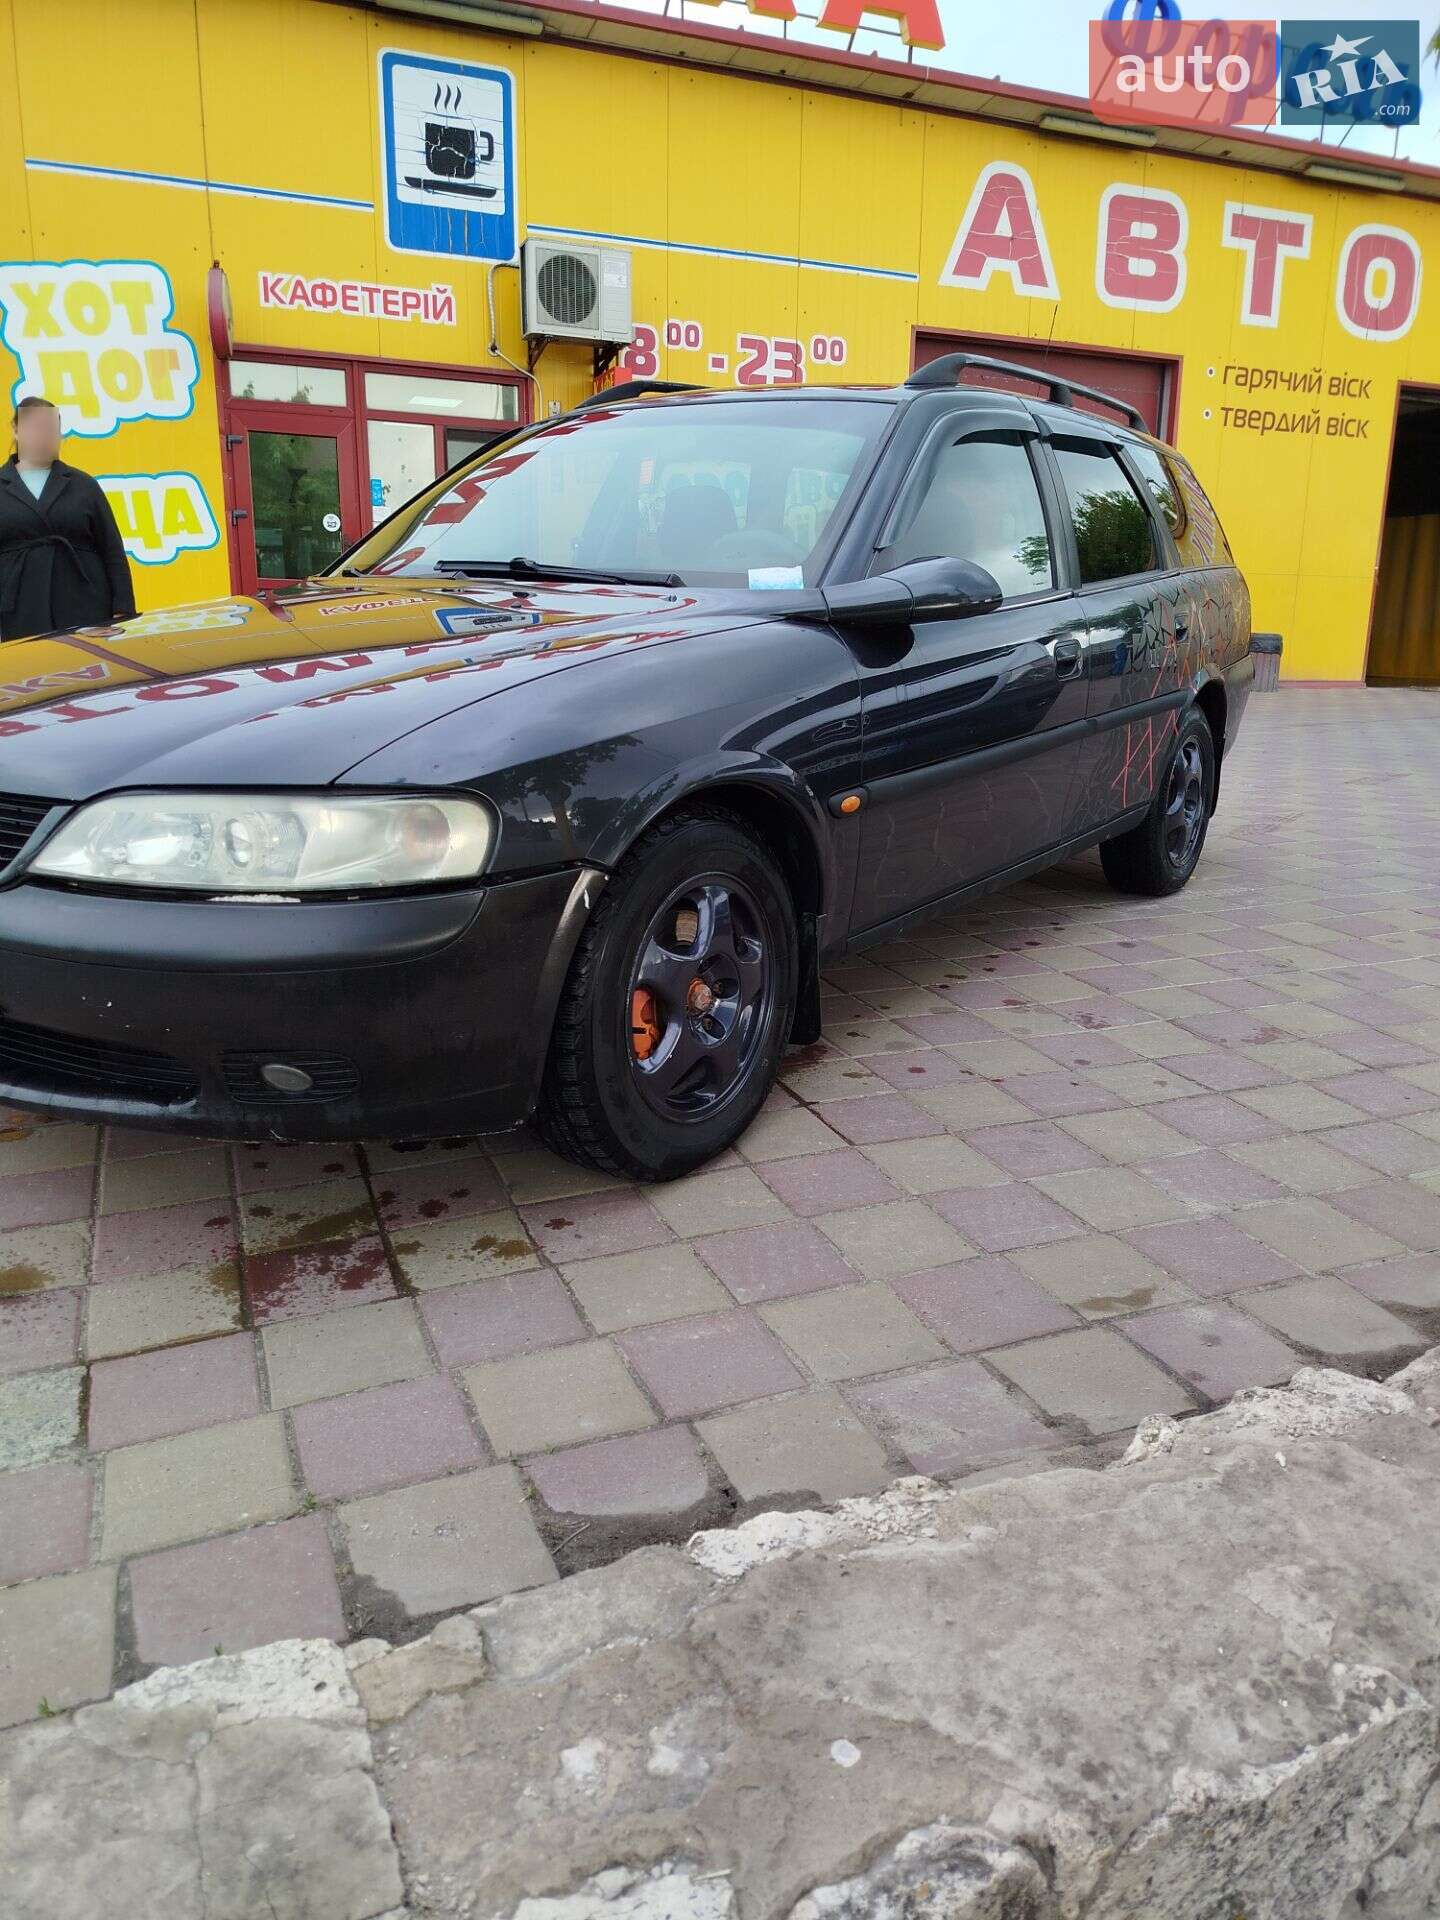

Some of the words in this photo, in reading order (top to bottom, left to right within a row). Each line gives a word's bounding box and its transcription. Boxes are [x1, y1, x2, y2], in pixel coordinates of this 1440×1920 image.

[943, 165, 1421, 337] АВТО
[9, 280, 154, 338] ХОТ
[260, 275, 454, 323] КАФЕТЕРІЙ
[37, 348, 181, 419] ДОГ
[1222, 364, 1323, 395] гарячий
[1327, 372, 1373, 400] віск
[1220, 406, 1321, 436] твердий
[1325, 412, 1370, 439] віск
